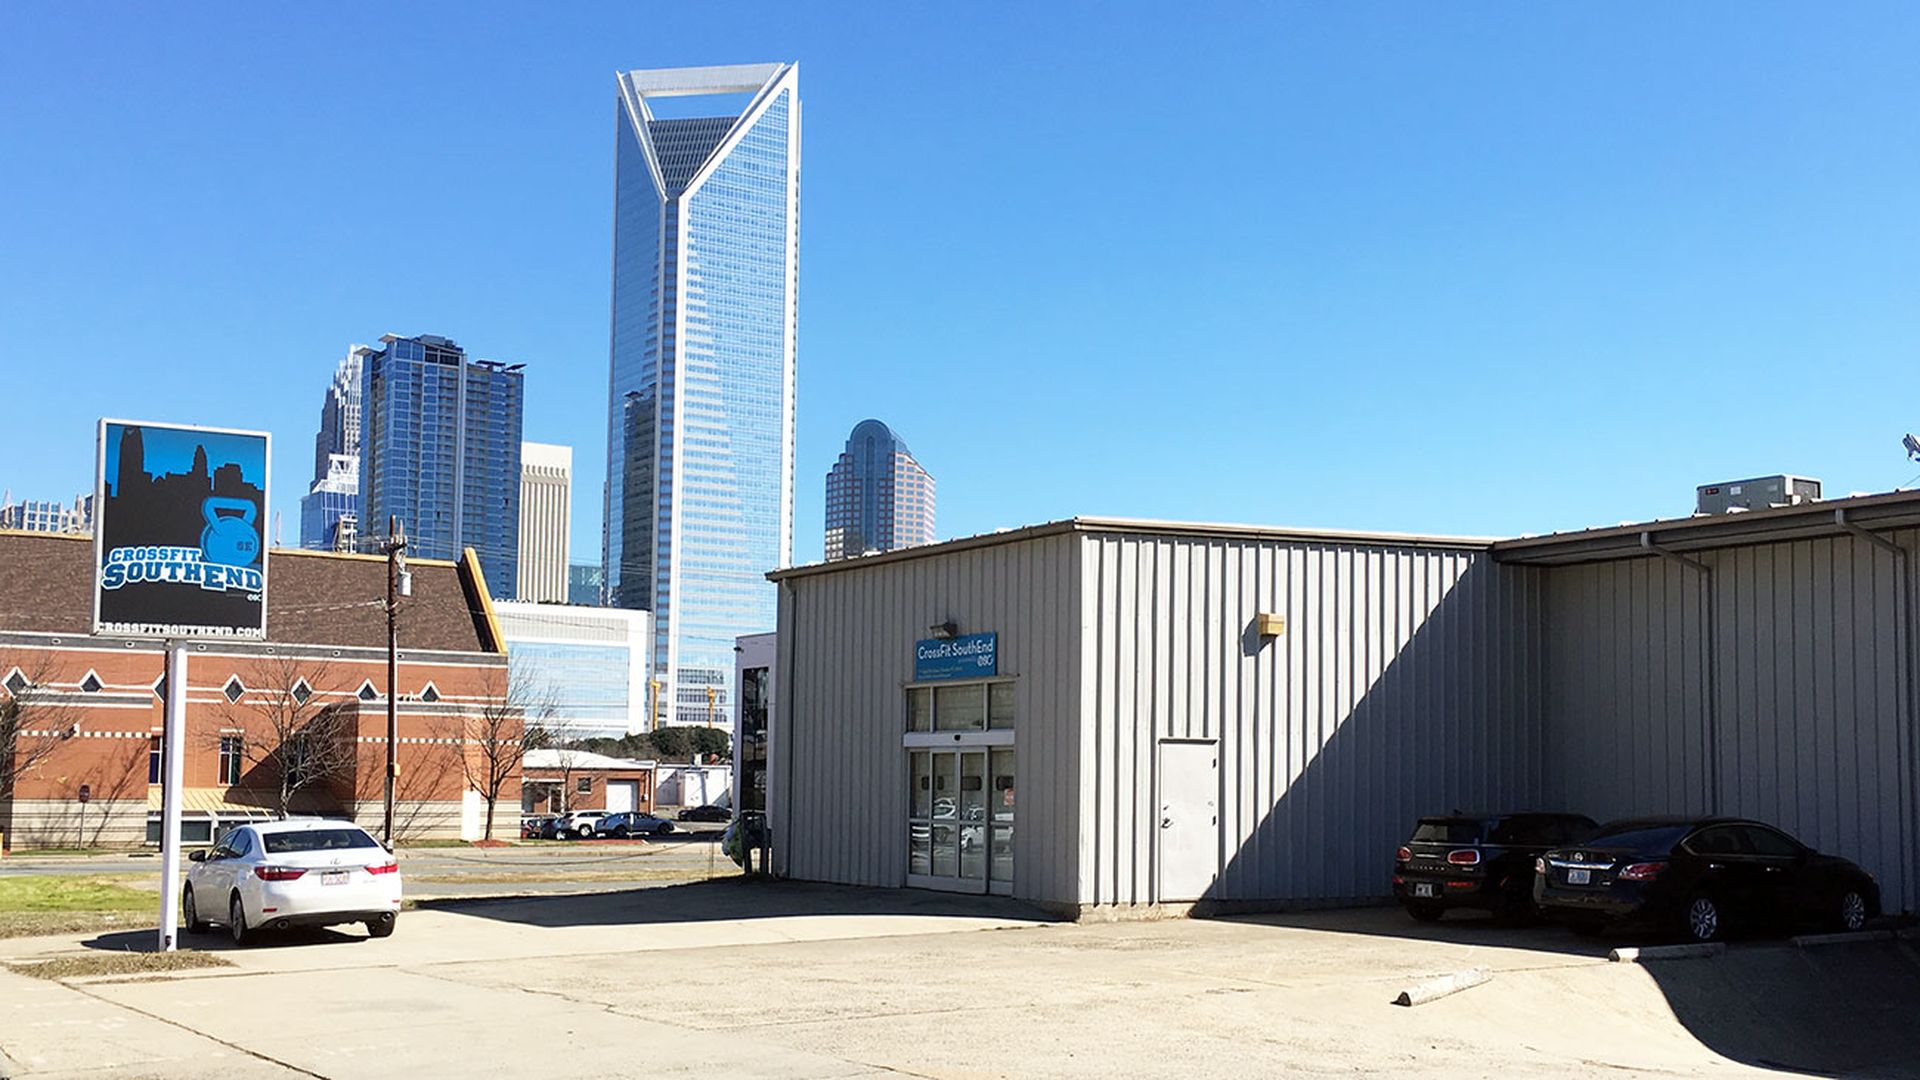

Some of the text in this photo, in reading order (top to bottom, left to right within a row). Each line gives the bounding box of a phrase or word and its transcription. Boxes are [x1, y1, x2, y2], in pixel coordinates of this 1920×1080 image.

[110, 547, 201, 563] CROSSFIT
[102, 561, 263, 593] SOUTHEND
[98, 621, 262, 638] CROSSFITSOUTHEND.COM
[918, 644, 952, 660] CrossFit
[952, 638, 994, 656] SouthEnd
